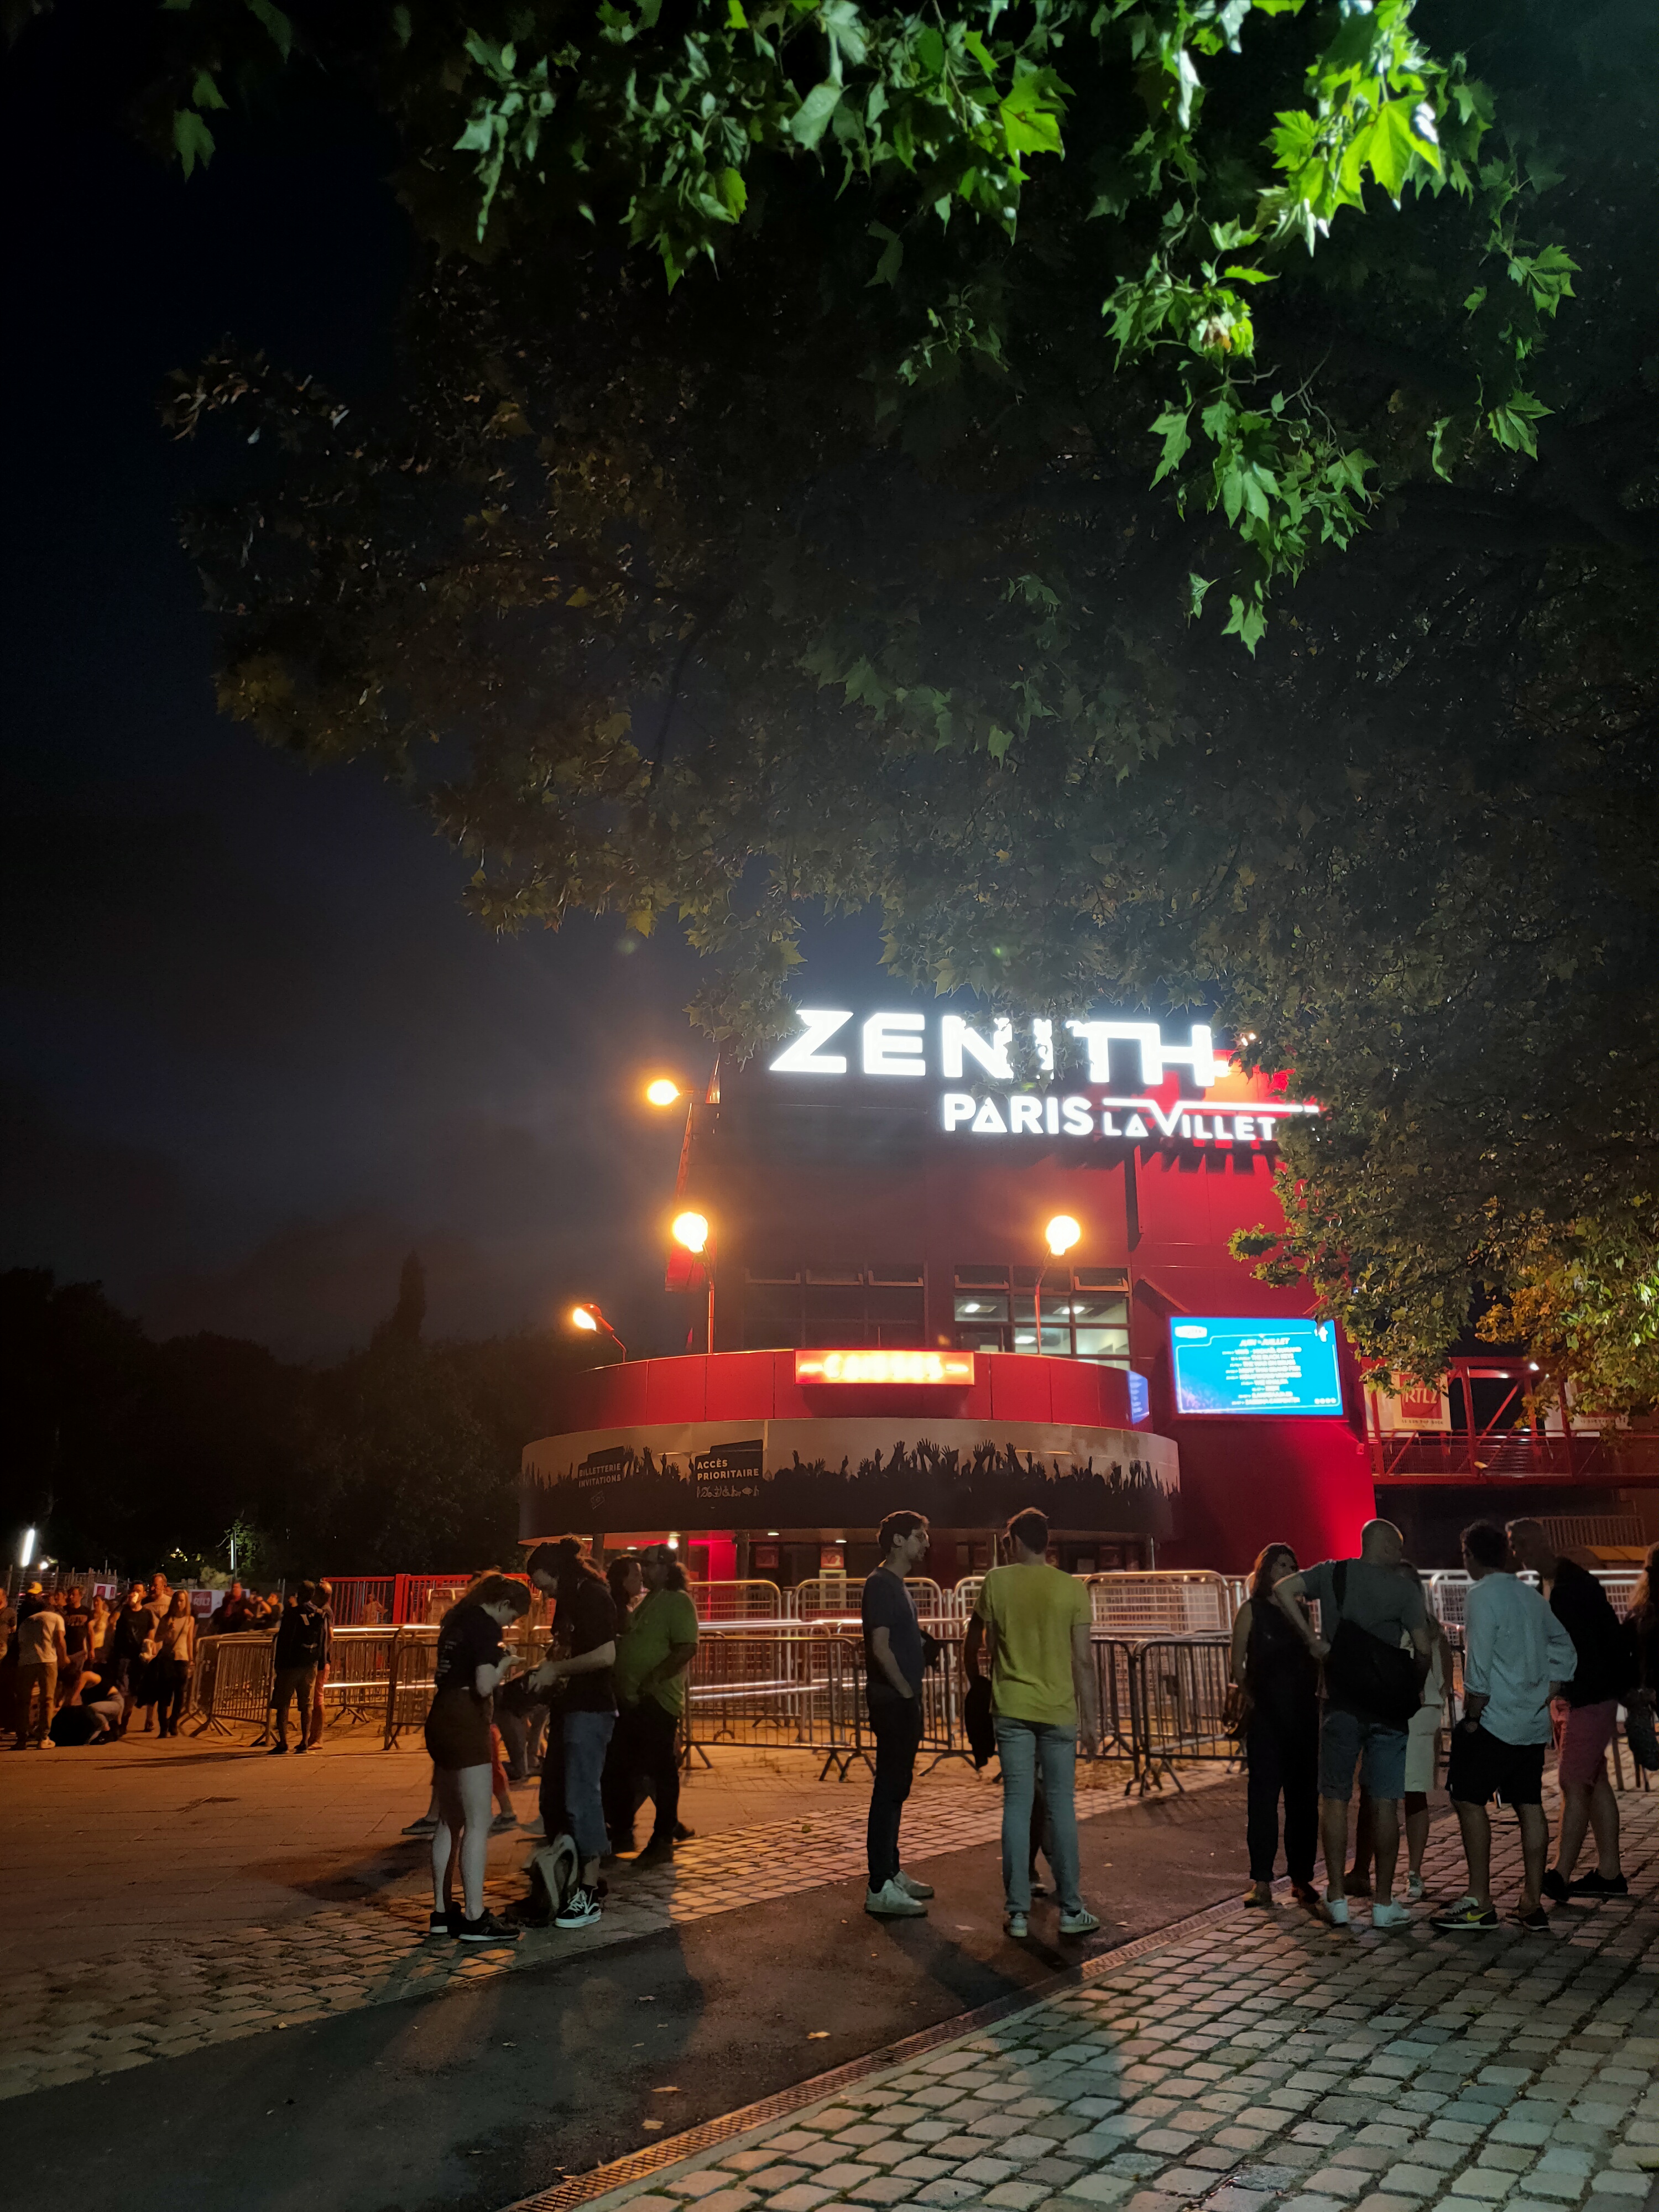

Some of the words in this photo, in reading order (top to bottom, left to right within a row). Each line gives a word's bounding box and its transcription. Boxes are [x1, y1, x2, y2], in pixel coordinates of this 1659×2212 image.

[769, 1010, 1215, 1087] ZENITH
[943, 1093, 1094, 1135] PARIS
[1104, 1111, 1149, 1136] LA
[1149, 1100, 1276, 1141] VILLET
[579, 1463, 621, 1477] BILLETTERIE
[697, 1458, 728, 1470] ACCÈS
[578, 1474, 622, 1488] INVITATIONS
[697, 1468, 760, 1481] PRIORITAIRE
